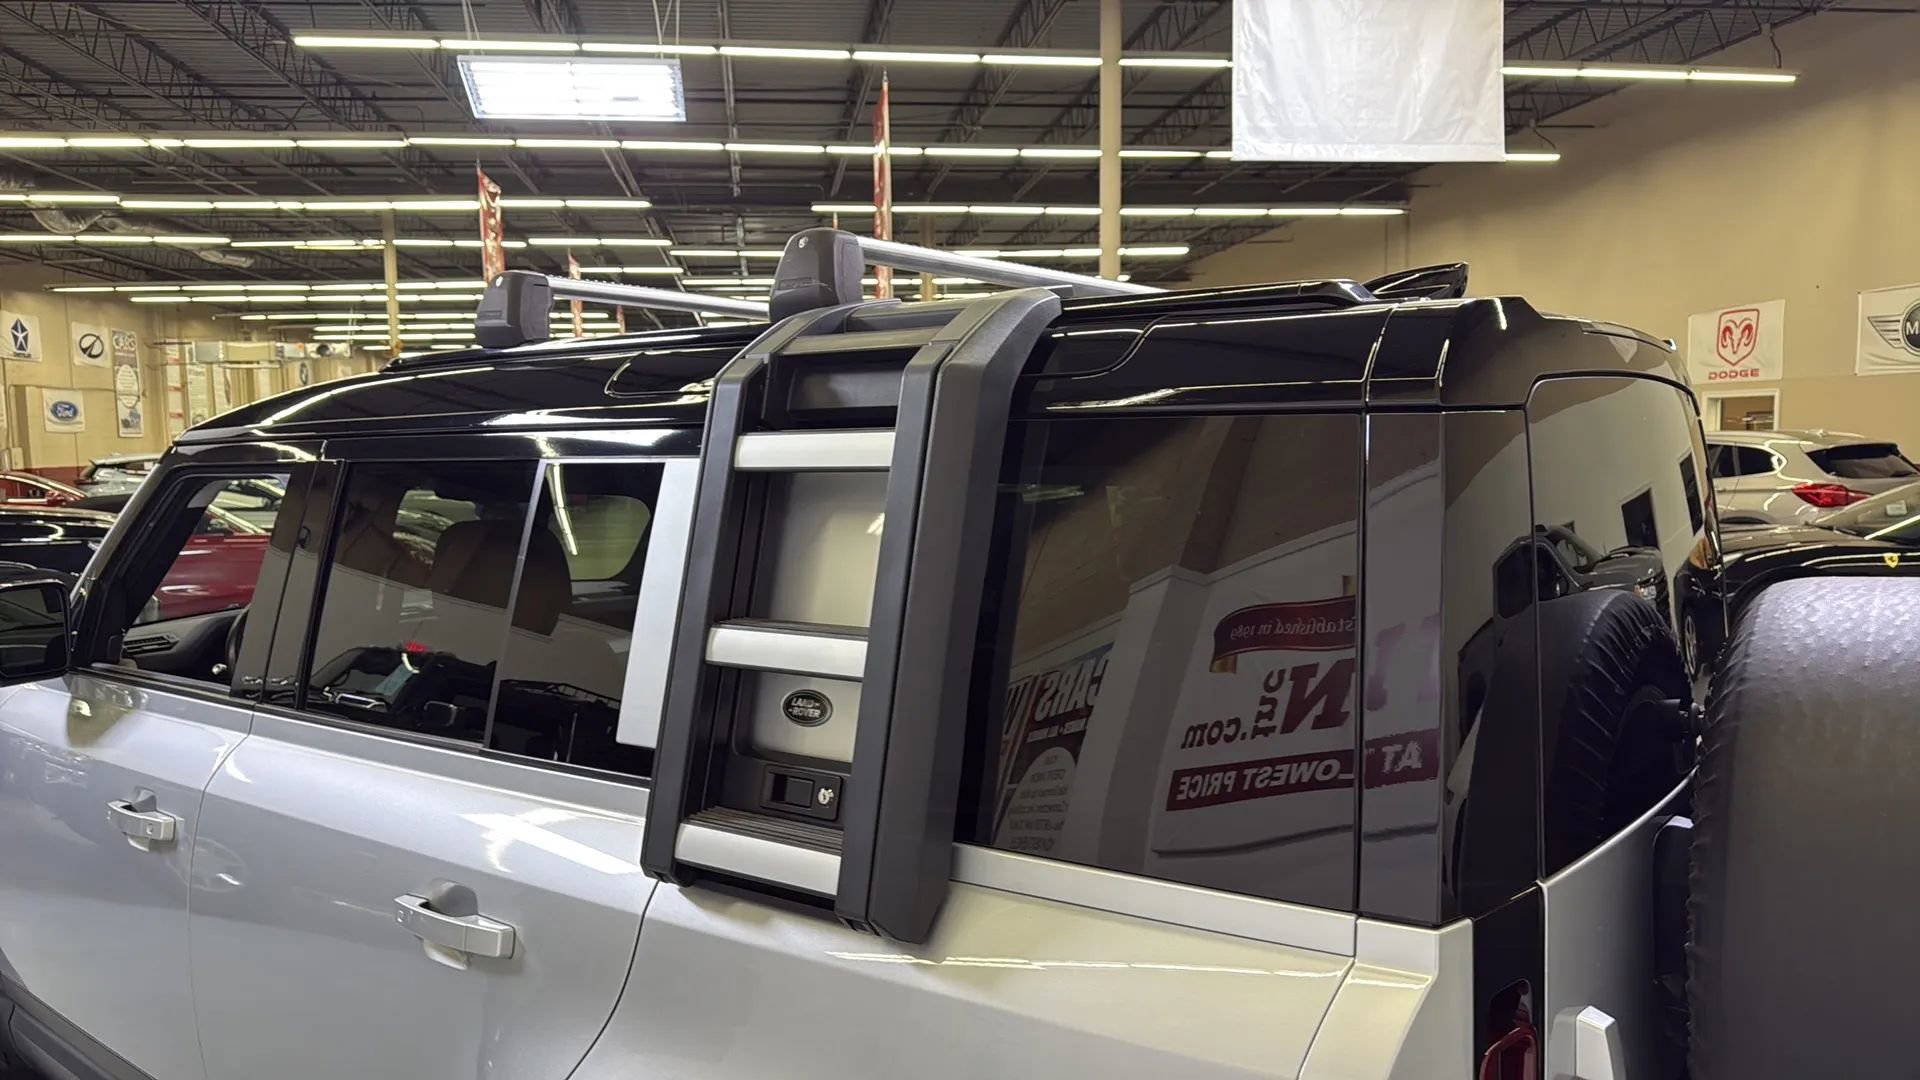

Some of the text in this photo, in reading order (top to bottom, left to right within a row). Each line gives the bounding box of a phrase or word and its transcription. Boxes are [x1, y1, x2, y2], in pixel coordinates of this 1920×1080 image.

[1708, 368, 1760, 380] DODGE
[791, 697, 814, 707] LAND
[792, 706, 821, 718] ROVER
